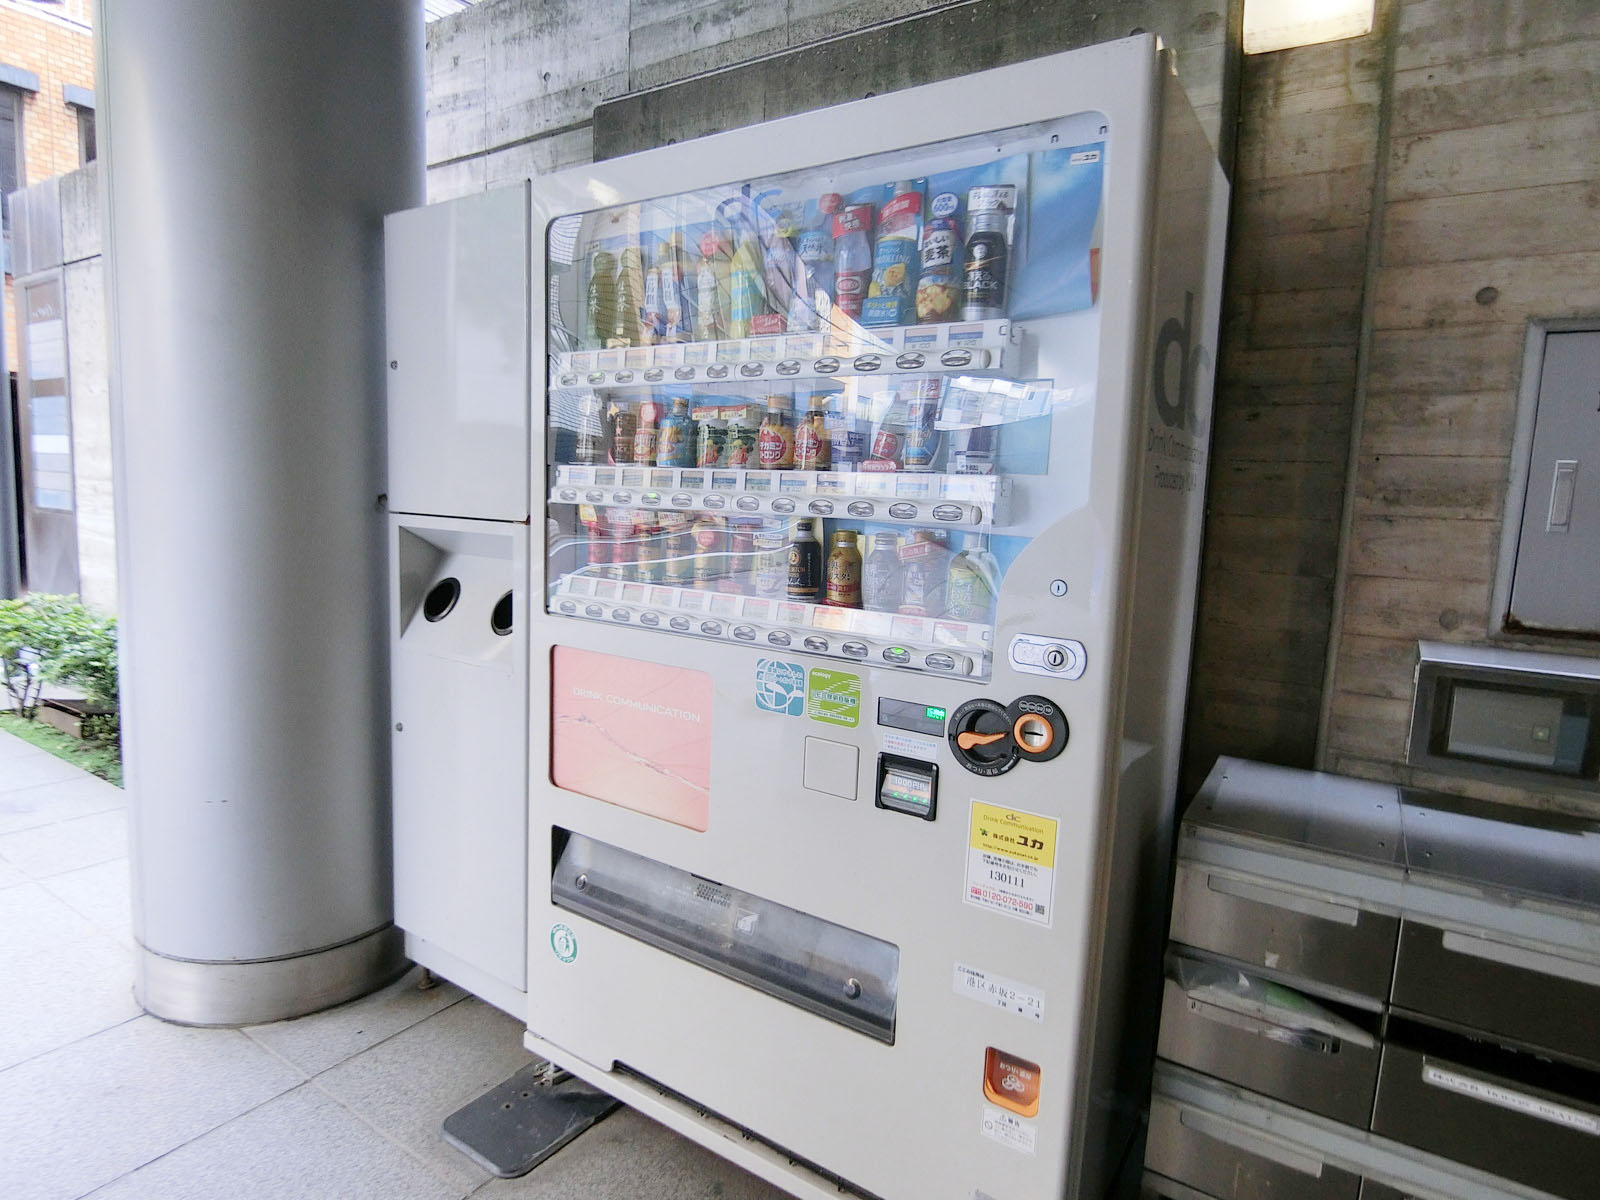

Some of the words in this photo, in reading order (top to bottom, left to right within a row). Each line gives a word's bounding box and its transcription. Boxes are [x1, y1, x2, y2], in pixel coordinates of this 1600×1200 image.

[572, 686, 602, 700] DRINK
[606, 694, 701, 723] COMMUNICATION
[983, 814, 998, 824] Drink
[999, 819, 1044, 834] Communication
[989, 869, 1024, 888] 130111
